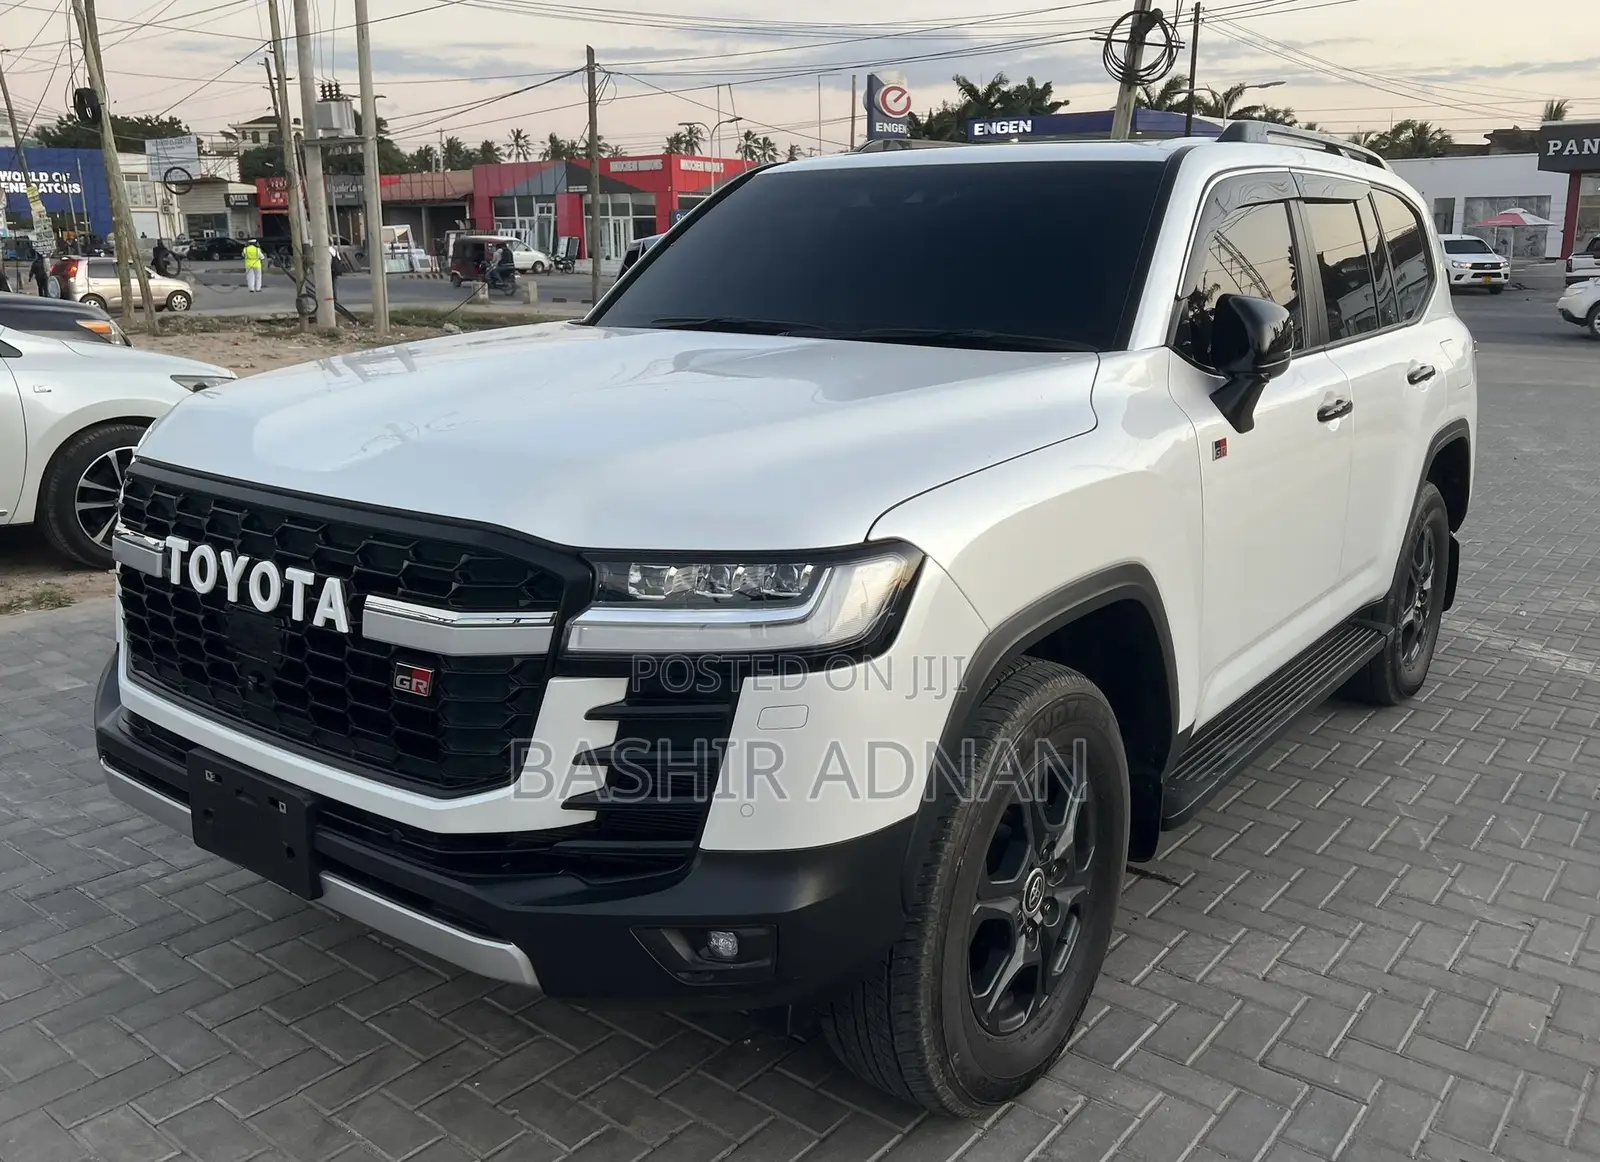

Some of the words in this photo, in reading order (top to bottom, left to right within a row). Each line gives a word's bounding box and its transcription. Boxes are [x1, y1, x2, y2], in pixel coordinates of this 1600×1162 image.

[974, 120, 1032, 136] ENGEN
[165, 535, 349, 634] TOYOTA
[395, 675, 428, 694] GR
